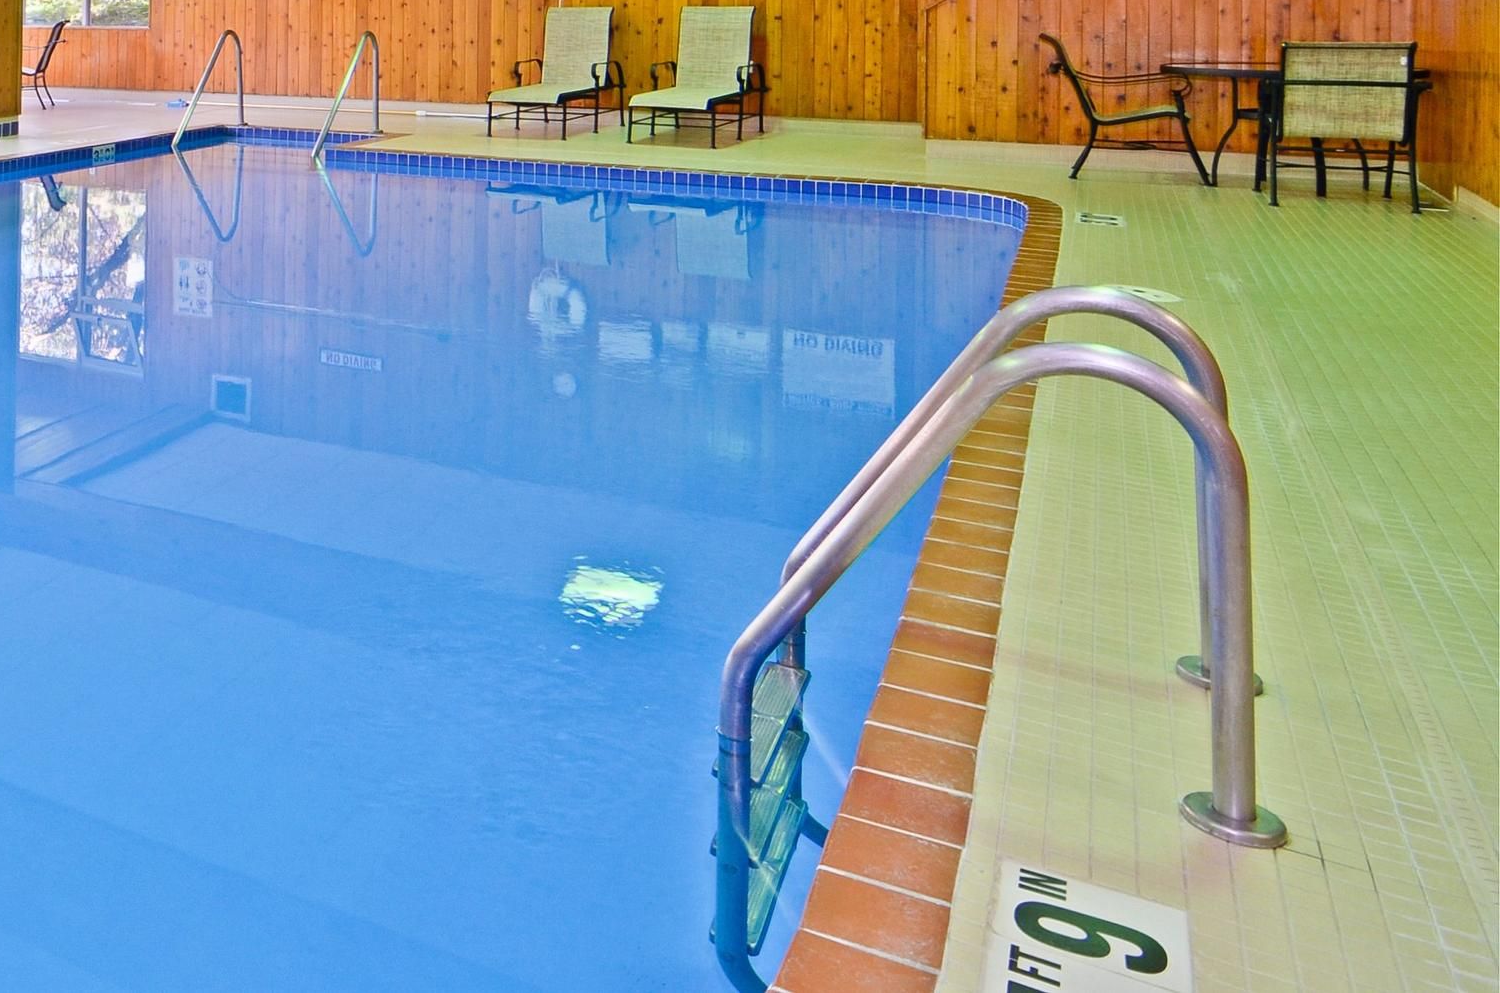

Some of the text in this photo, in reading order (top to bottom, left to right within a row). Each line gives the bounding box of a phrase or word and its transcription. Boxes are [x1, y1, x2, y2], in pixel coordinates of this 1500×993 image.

[1018, 868, 1068, 901] IN
[1014, 901, 1169, 975] 9
[1008, 943, 1062, 988] FT
